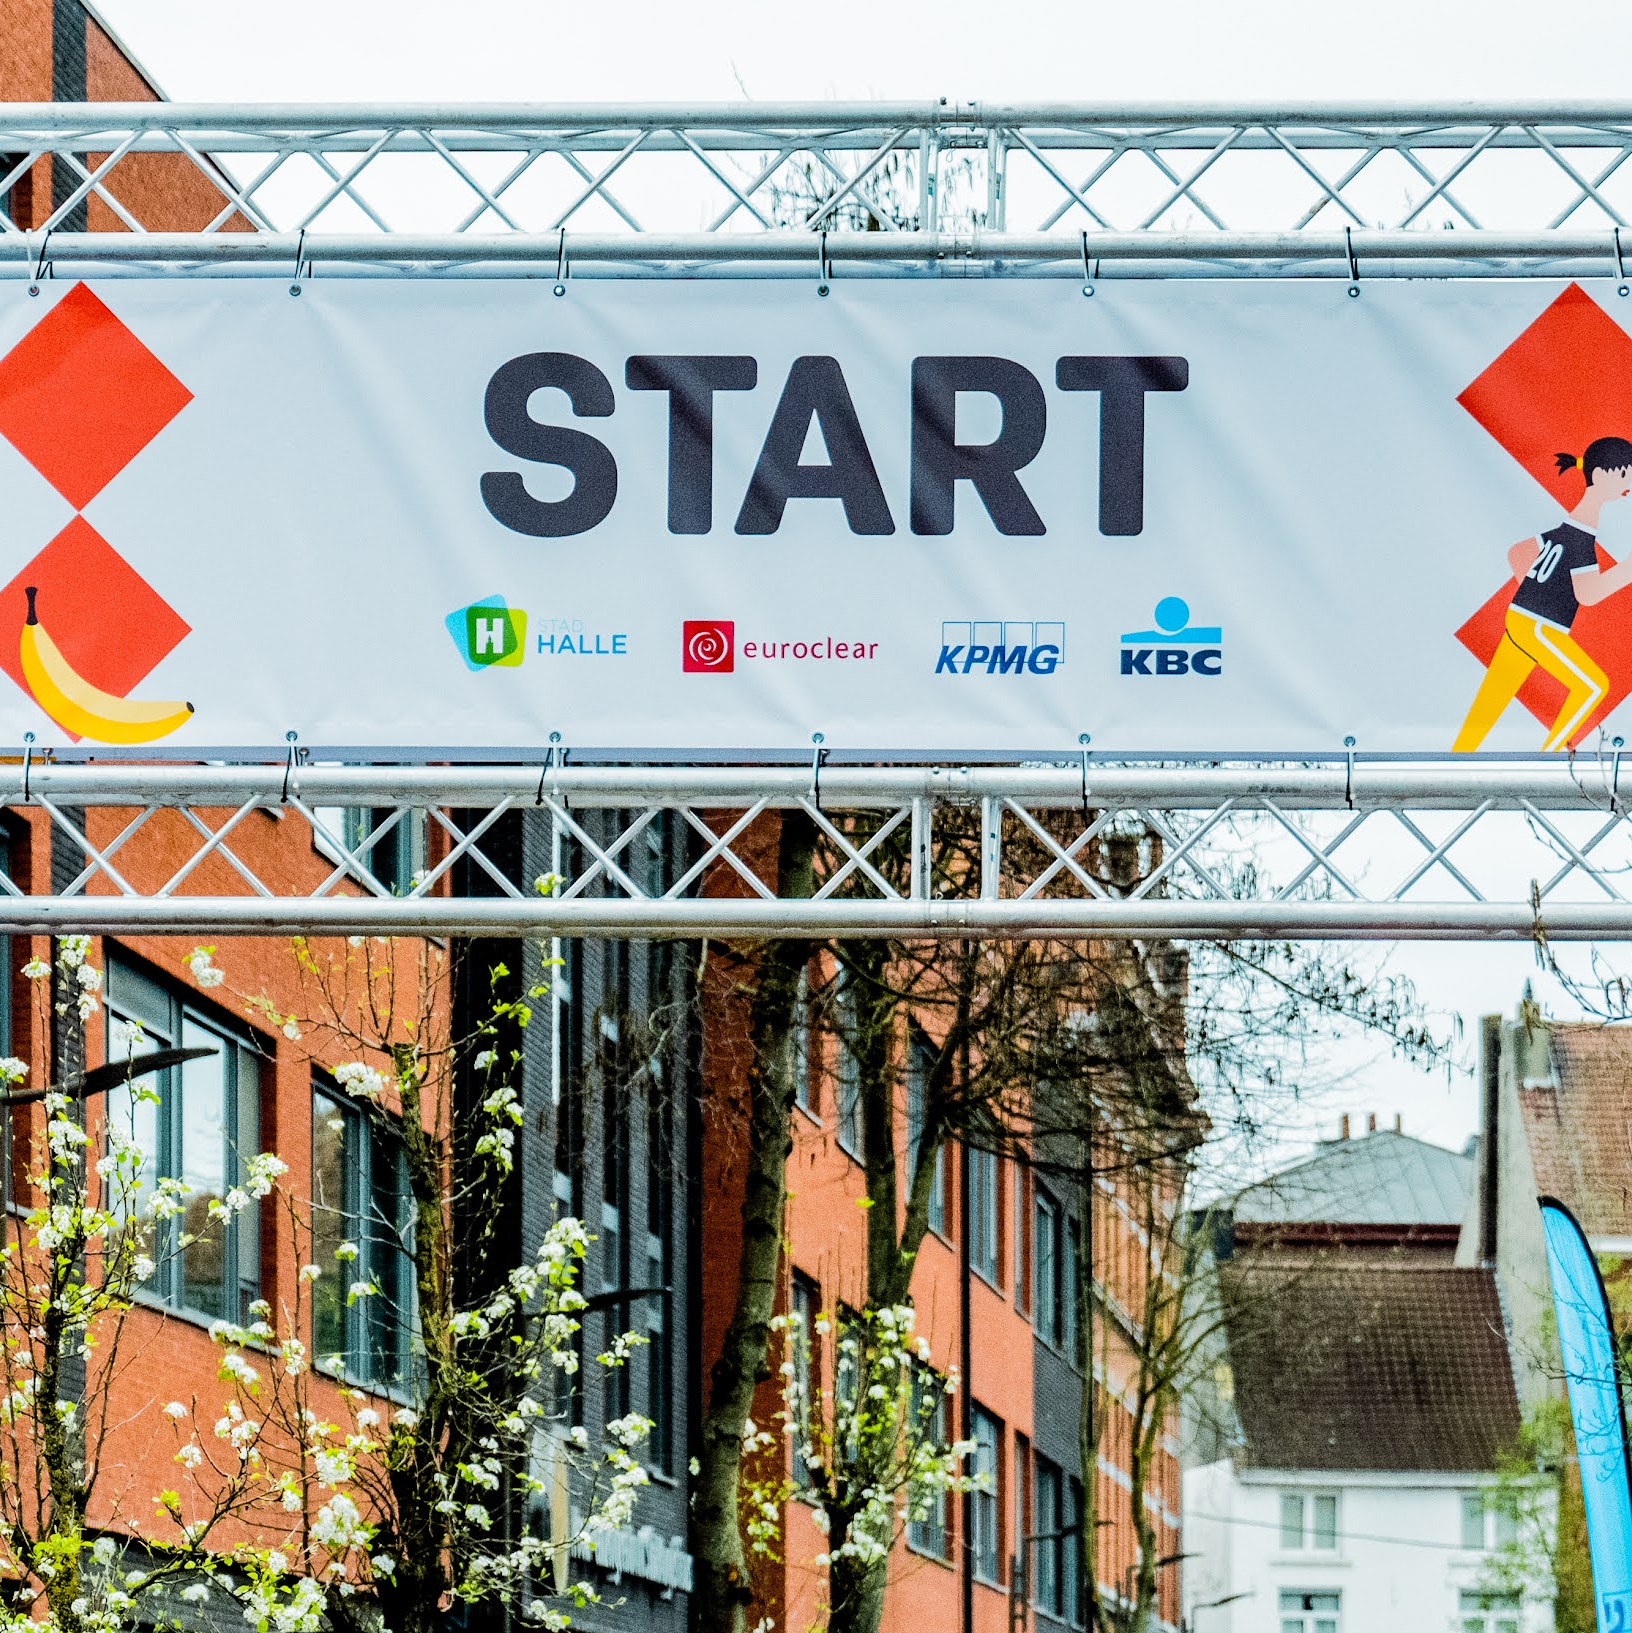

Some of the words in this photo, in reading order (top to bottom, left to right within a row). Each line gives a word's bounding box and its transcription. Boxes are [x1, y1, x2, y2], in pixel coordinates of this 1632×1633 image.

[480, 351, 1189, 538] START
[538, 634, 627, 654] HALLE
[743, 636, 879, 659] euroclear
[935, 644, 1060, 675] KPMG
[1120, 649, 1222, 675] KBC
